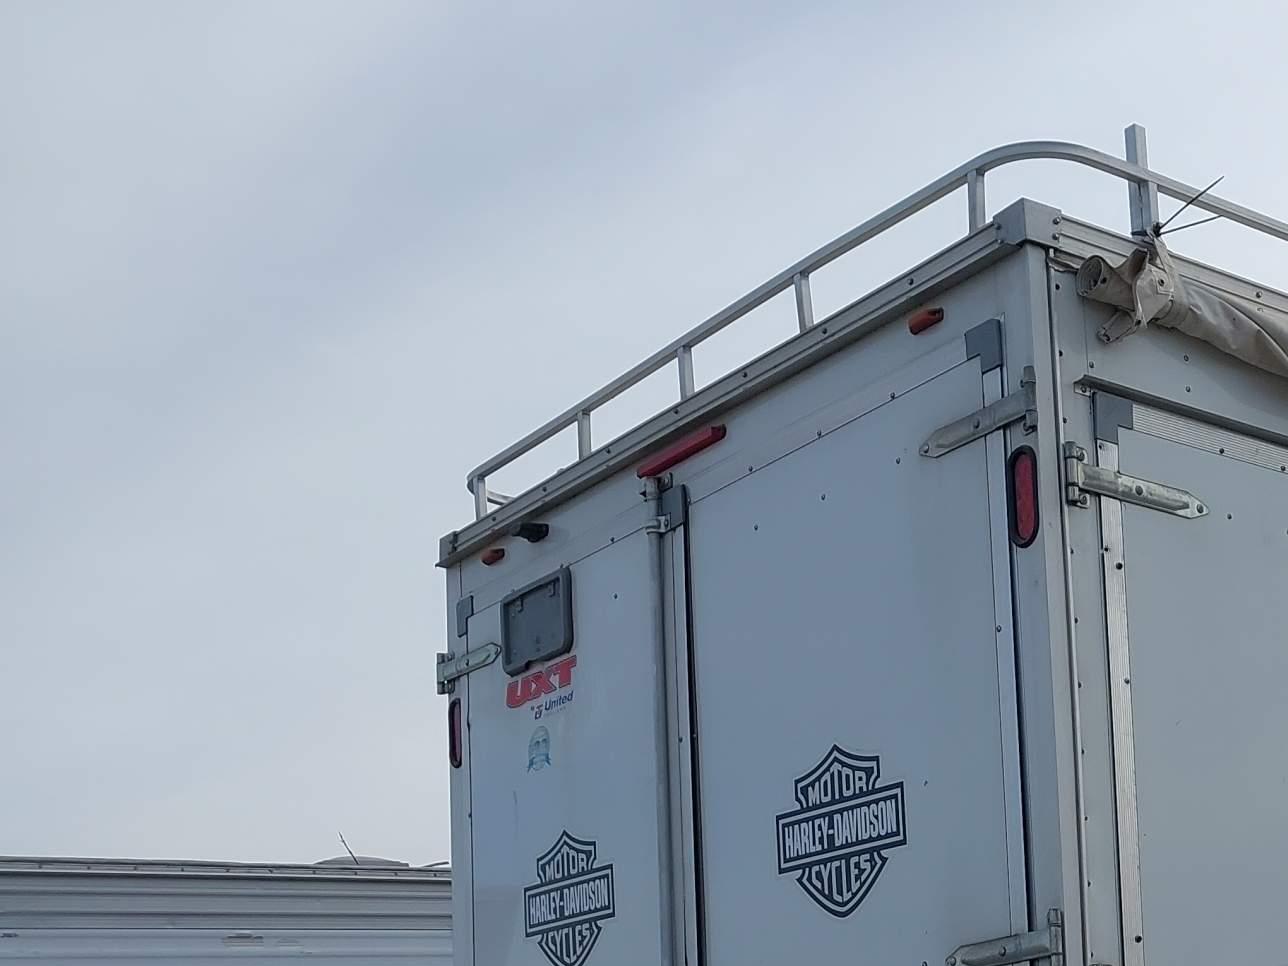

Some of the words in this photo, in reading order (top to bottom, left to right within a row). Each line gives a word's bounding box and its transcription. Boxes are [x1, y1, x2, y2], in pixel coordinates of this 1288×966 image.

[506, 655, 577, 709] UXT
[544, 691, 574, 711] United
[807, 762, 867, 808] MOTOR
[784, 799, 897, 859] HARLEY-DAVIDSON
[545, 845, 587, 882] MOTOR
[811, 853, 871, 903] CYCLES
[530, 877, 608, 925] HARLEY-DAVIDSON
[548, 921, 590, 965] CYCLES
